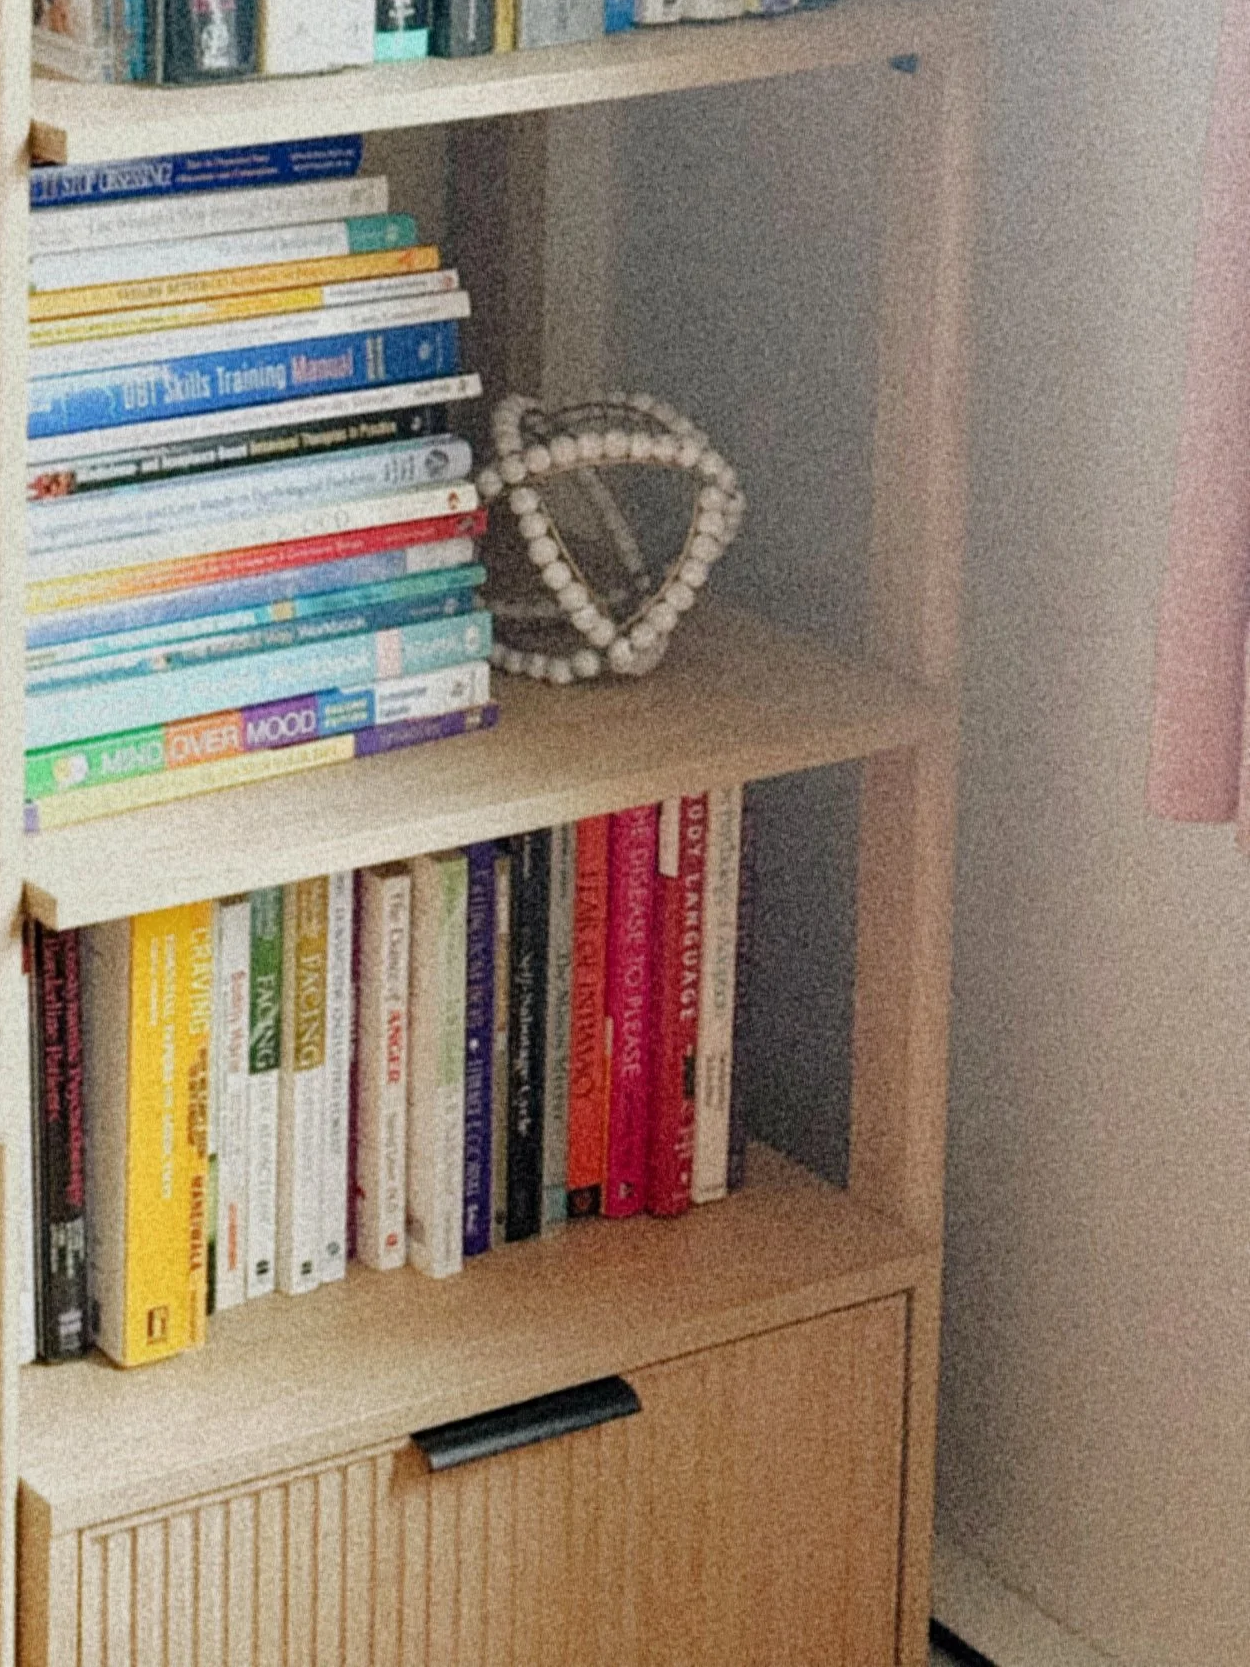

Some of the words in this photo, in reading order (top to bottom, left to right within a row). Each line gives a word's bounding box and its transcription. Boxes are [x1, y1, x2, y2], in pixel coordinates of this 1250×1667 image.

[122, 379, 158, 411] DBT
[162, 364, 212, 405] Skills
[215, 359, 286, 396] Training
[290, 348, 355, 384] Manual
[99, 739, 165, 776] MIND
[170, 725, 240, 762] OVER
[246, 707, 317, 744] MOOD
[631, 808, 649, 837] HE
[626, 849, 649, 944] DISEASE
[188, 926, 213, 1036] CRAVING
[624, 954, 646, 987] TO
[679, 873, 701, 1022] LANGUAGE
[255, 973, 277, 1070] FACING
[300, 953, 321, 1066] FACING
[387, 1008, 402, 1084] ANGER
[573, 981, 598, 1099] INTIMACY
[621, 996, 644, 1078] PLEASE
